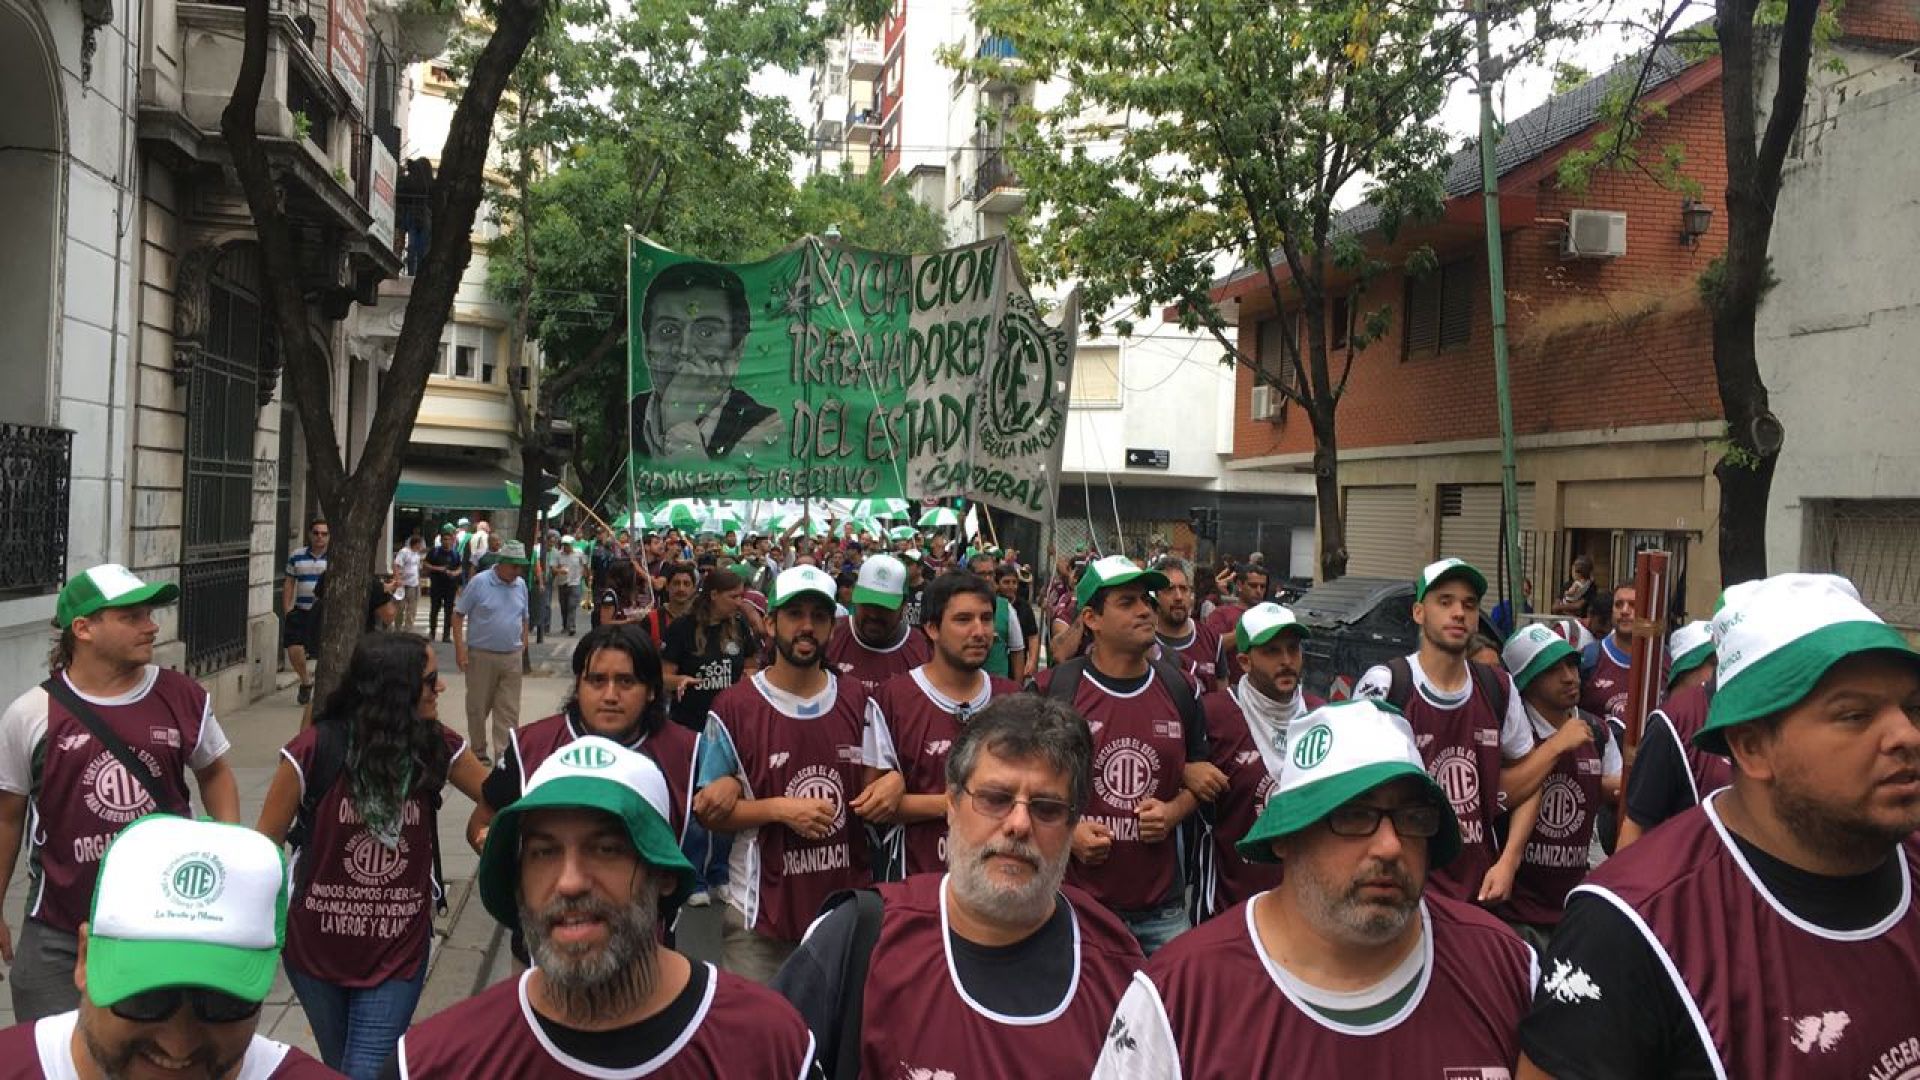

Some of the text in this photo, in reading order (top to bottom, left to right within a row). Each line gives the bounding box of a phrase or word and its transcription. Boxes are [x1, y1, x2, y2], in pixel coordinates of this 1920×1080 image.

[795, 242, 999, 316] ASOCIACION
[792, 398, 853, 460] DEL
[746, 463, 880, 495] DIRECTIVO
[1140, 744, 1160, 771] ESTADO
[1296, 729, 1328, 765] ATE
[1109, 756, 1146, 795] ATE
[1441, 763, 1475, 801] ATE
[1543, 789, 1571, 825] ATE
[358, 841, 393, 873] ATE
[177, 866, 212, 895] ATE
[311, 882, 345, 898] UNIDOS
[346, 886, 382, 901] SOMOS
[305, 896, 374, 915] ORGANIZADOS
[320, 914, 334, 934] LA
[335, 915, 369, 937] VERDE
[369, 917, 378, 937] Y
